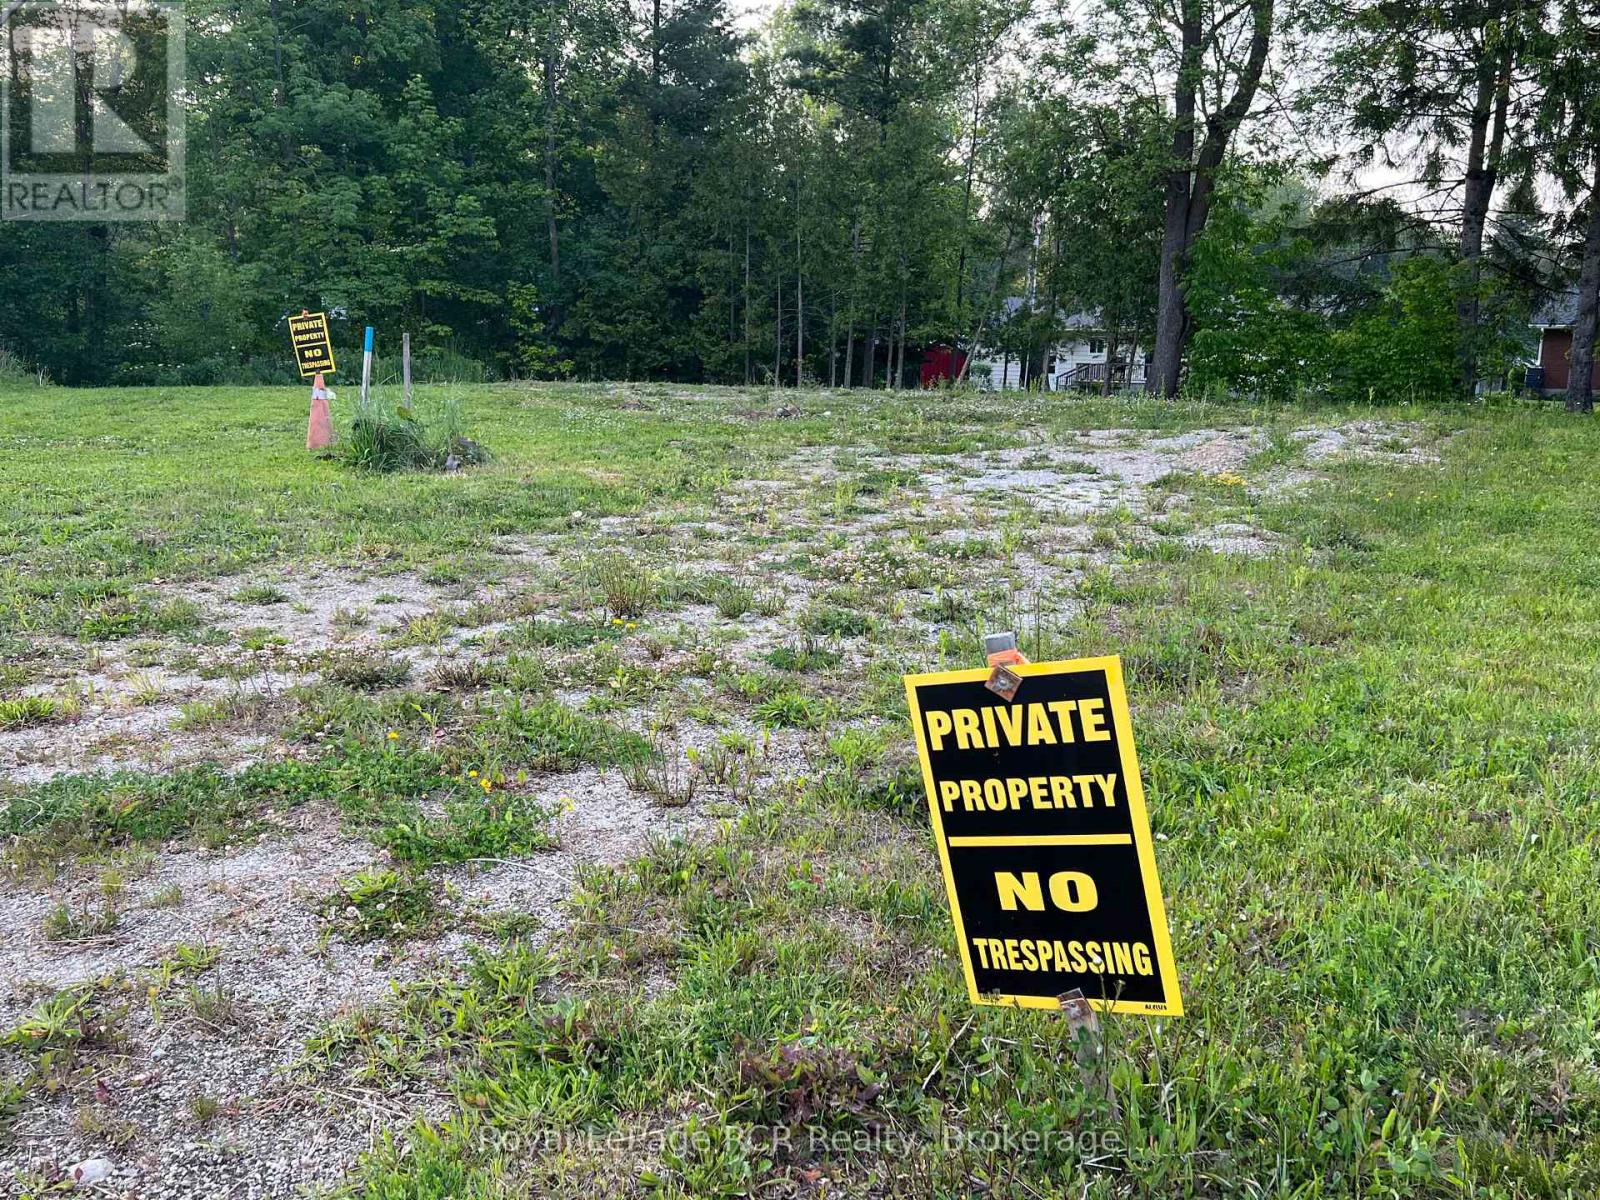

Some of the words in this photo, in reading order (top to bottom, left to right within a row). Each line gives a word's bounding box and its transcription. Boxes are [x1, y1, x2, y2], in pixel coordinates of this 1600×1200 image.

[292, 319, 323, 331] PRIVATE
[295, 332, 324, 342] PROPERTY
[304, 349, 322, 358] NO
[926, 698, 1111, 750] PRIVATE
[940, 773, 1117, 812] PROPERTY
[994, 871, 1098, 913] NO
[972, 938, 1154, 976] TRESPASSING
